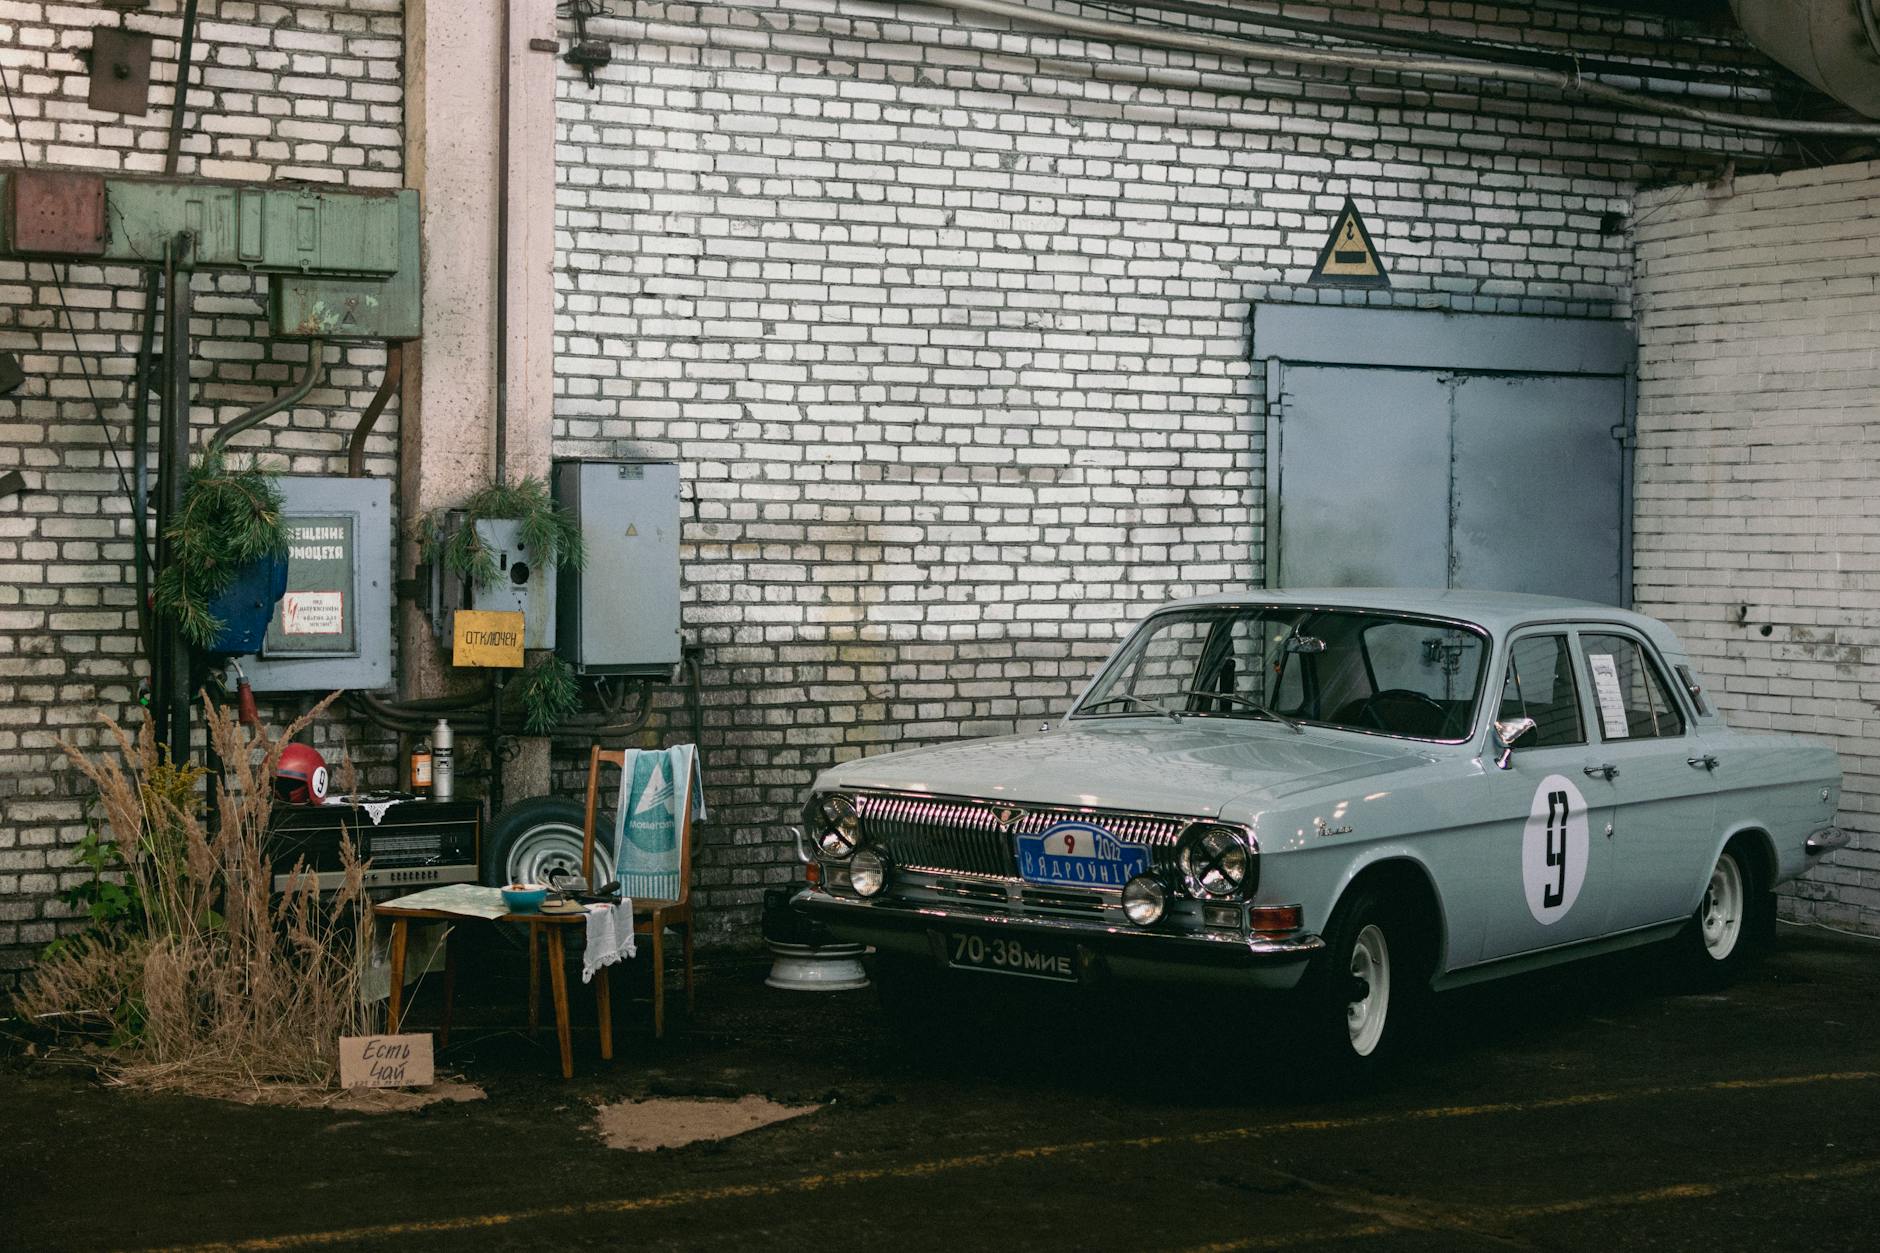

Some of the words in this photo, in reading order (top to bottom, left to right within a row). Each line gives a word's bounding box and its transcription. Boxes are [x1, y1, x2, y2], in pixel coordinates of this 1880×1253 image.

[465, 630, 517, 647] ОТКЛЮЧЕН
[317, 769, 326, 794] 9
[1063, 834, 1075, 854] 9
[1095, 834, 1122, 862] 2022
[1543, 791, 1569, 908] 9
[362, 1039, 410, 1060] Есть
